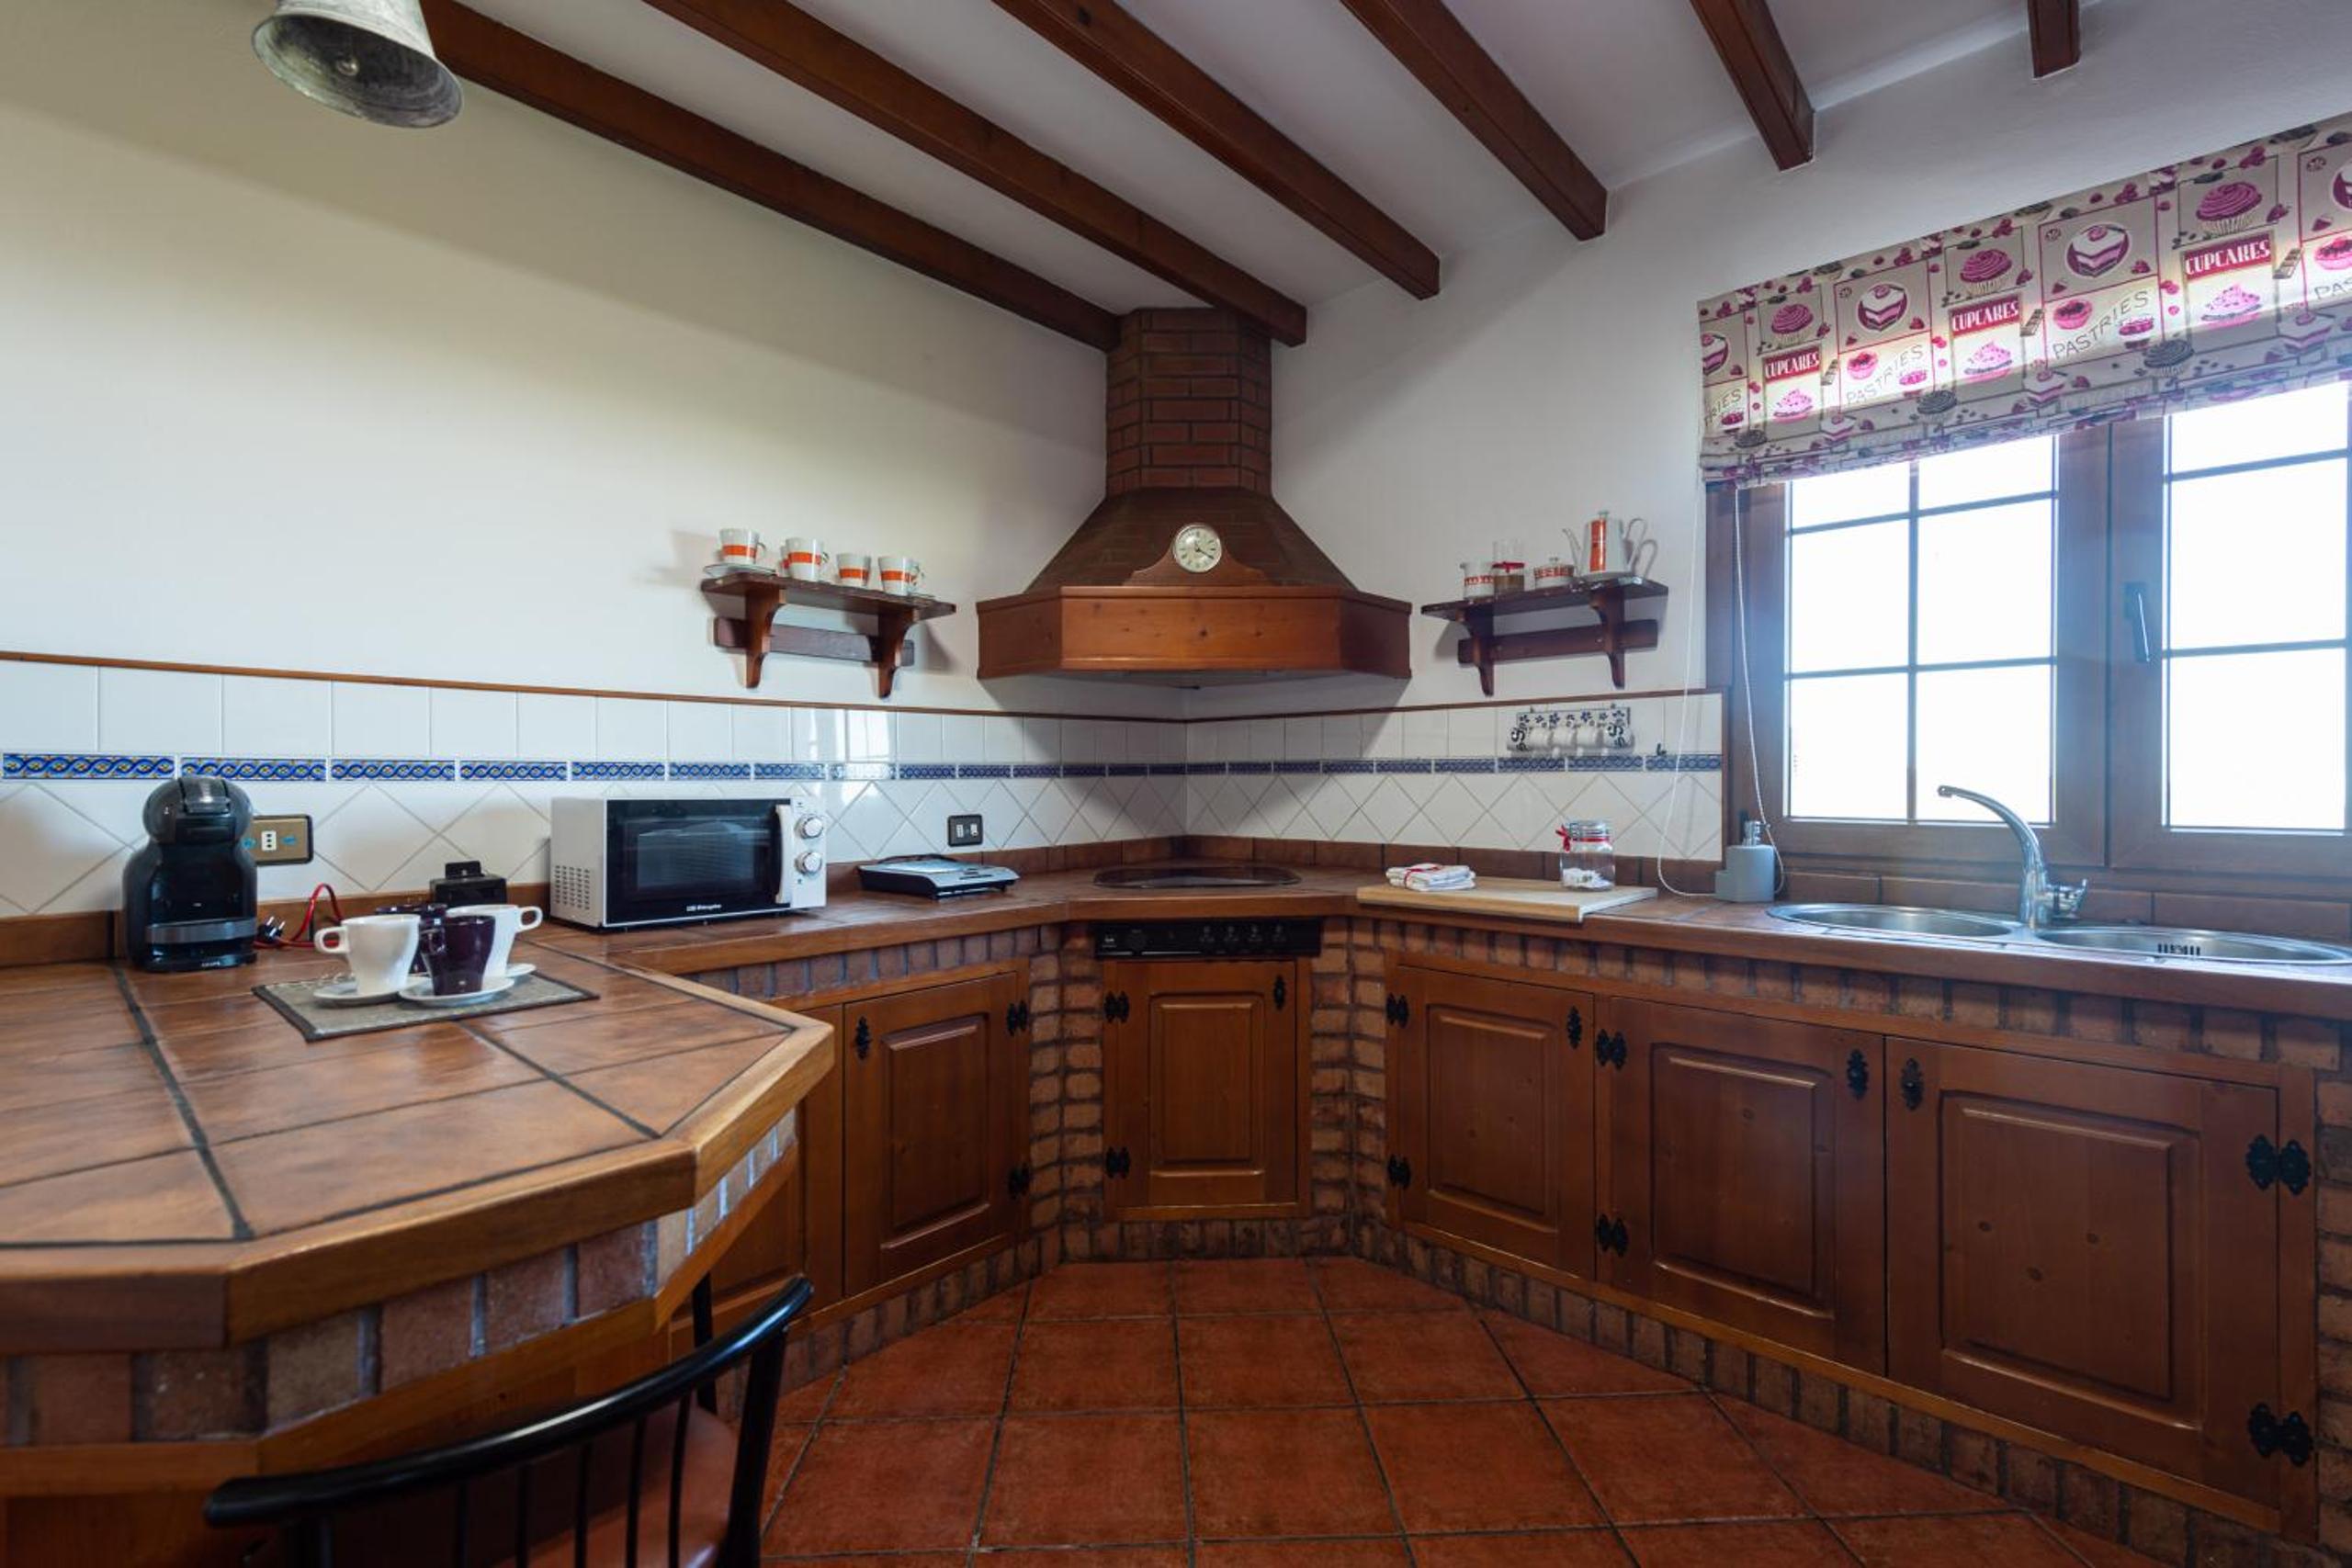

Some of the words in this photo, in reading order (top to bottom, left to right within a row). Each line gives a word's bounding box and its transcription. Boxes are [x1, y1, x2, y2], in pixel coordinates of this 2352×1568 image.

[2186, 240, 2271, 276] CUPCAKES
[1952, 300, 2019, 332] CUPCAKES
[2052, 290, 2149, 360] PASTRIES
[1765, 352, 1820, 378] CUPCAKES
[1847, 344, 1924, 405] PASTRIES
